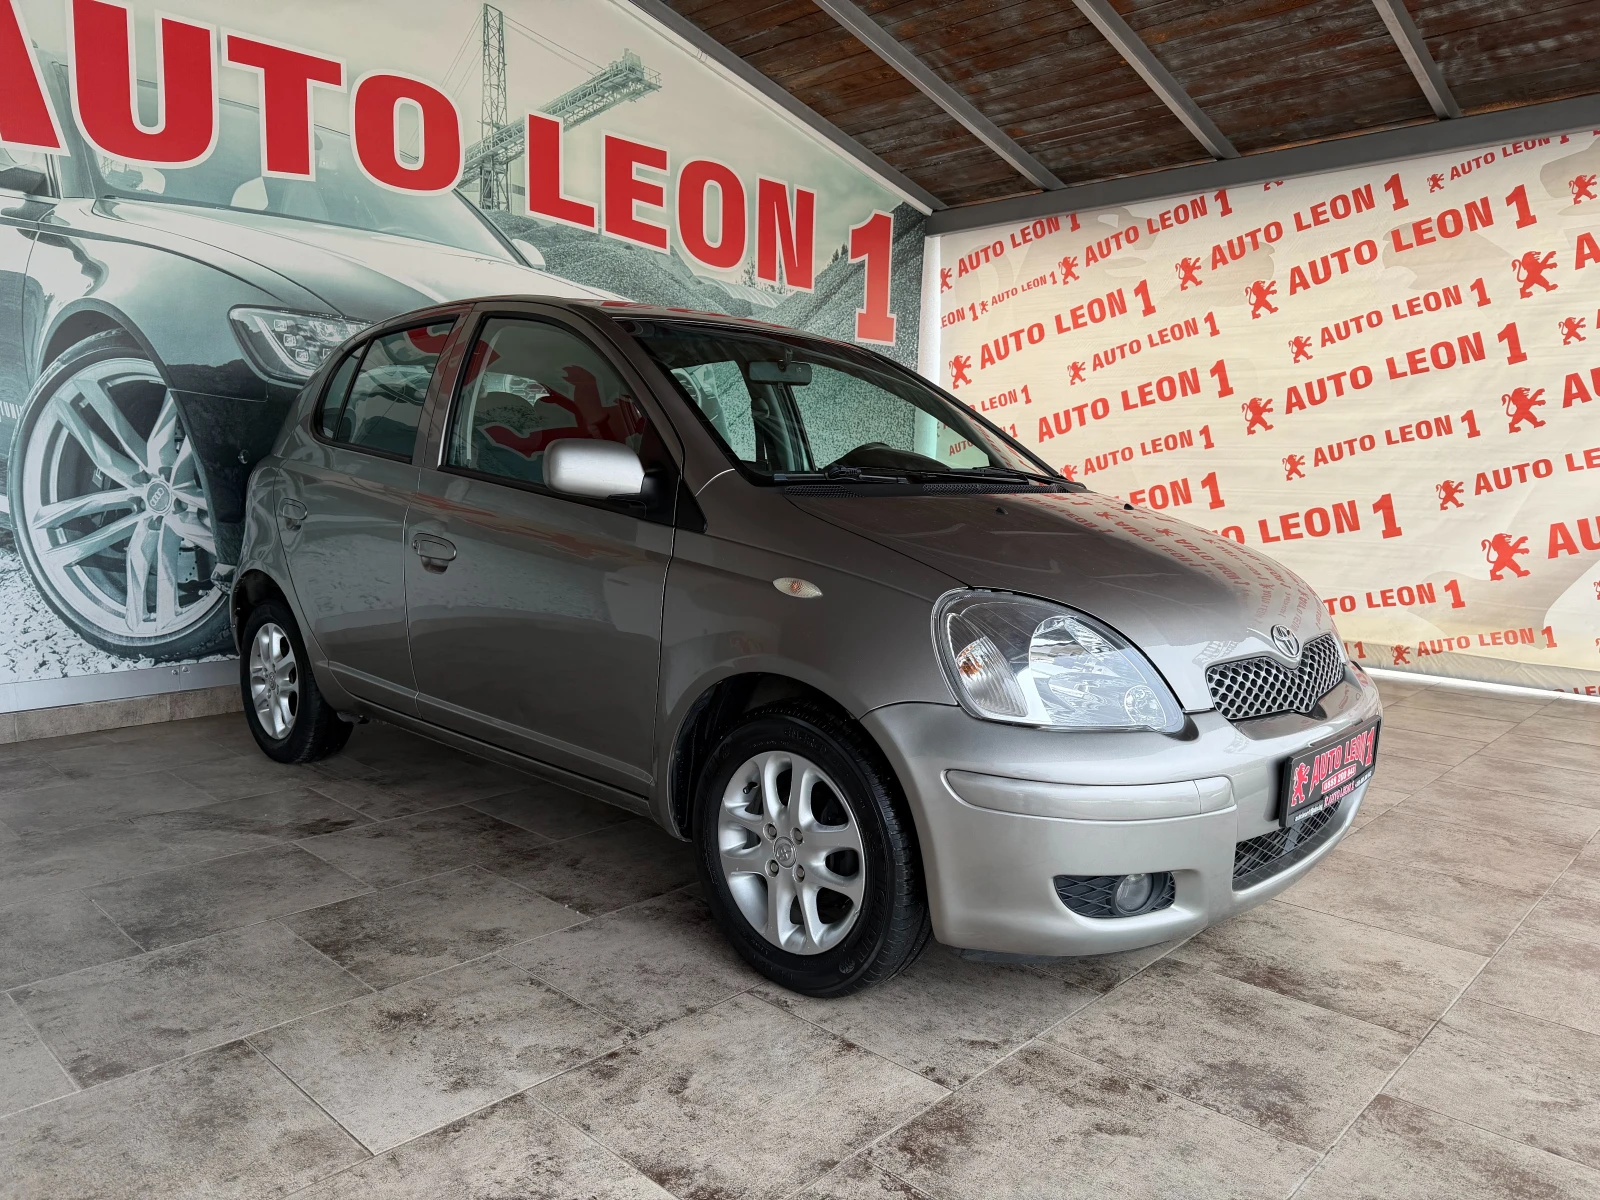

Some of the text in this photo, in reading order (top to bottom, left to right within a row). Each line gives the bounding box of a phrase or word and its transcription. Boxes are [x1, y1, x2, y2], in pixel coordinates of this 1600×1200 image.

[1450, 152, 1496, 180] AUTO
[526, 111, 817, 292] LEON
[849, 210, 896, 344] 1
[958, 212, 1081, 278] AUTO LEON 1
[1085, 190, 1233, 267] AUTO LEON 1
[1211, 173, 1409, 271] AUTO LEON 1
[1289, 184, 1538, 296] AUTO LEON 1
[940, 302, 979, 329] EON 1
[991, 271, 1058, 306] AUTO LEON 1
[1320, 277, 1491, 348] AUTO LEON 1
[980, 279, 1157, 370] AUTO LEON 1
[1092, 311, 1221, 372] AUTO LEON 1
[1285, 322, 1528, 415] AUTO LEON 1
[981, 384, 1032, 412] LEON 1
[1038, 397, 1110, 443] AUTO
[1120, 367, 1201, 411] LEON
[1209, 359, 1235, 399] 1
[1009, 423, 1018, 438] 1
[1083, 424, 1215, 476] AUTO LEON 1
[1313, 409, 1481, 468] AUTO LEON 1
[1200, 471, 1226, 510] 1
[1474, 458, 1553, 496] AUTO
[1258, 499, 1361, 544] LEON
[1372, 493, 1403, 539] 1
[1365, 582, 1437, 609] LEON
[1443, 579, 1466, 609] 1
[1354, 641, 1366, 659] 1
[1417, 625, 1557, 657] AUTO LEON 1
[1308, 745, 1342, 798] AUTO
[1344, 731, 1367, 766] LEON
[1365, 727, 1375, 767] 1
